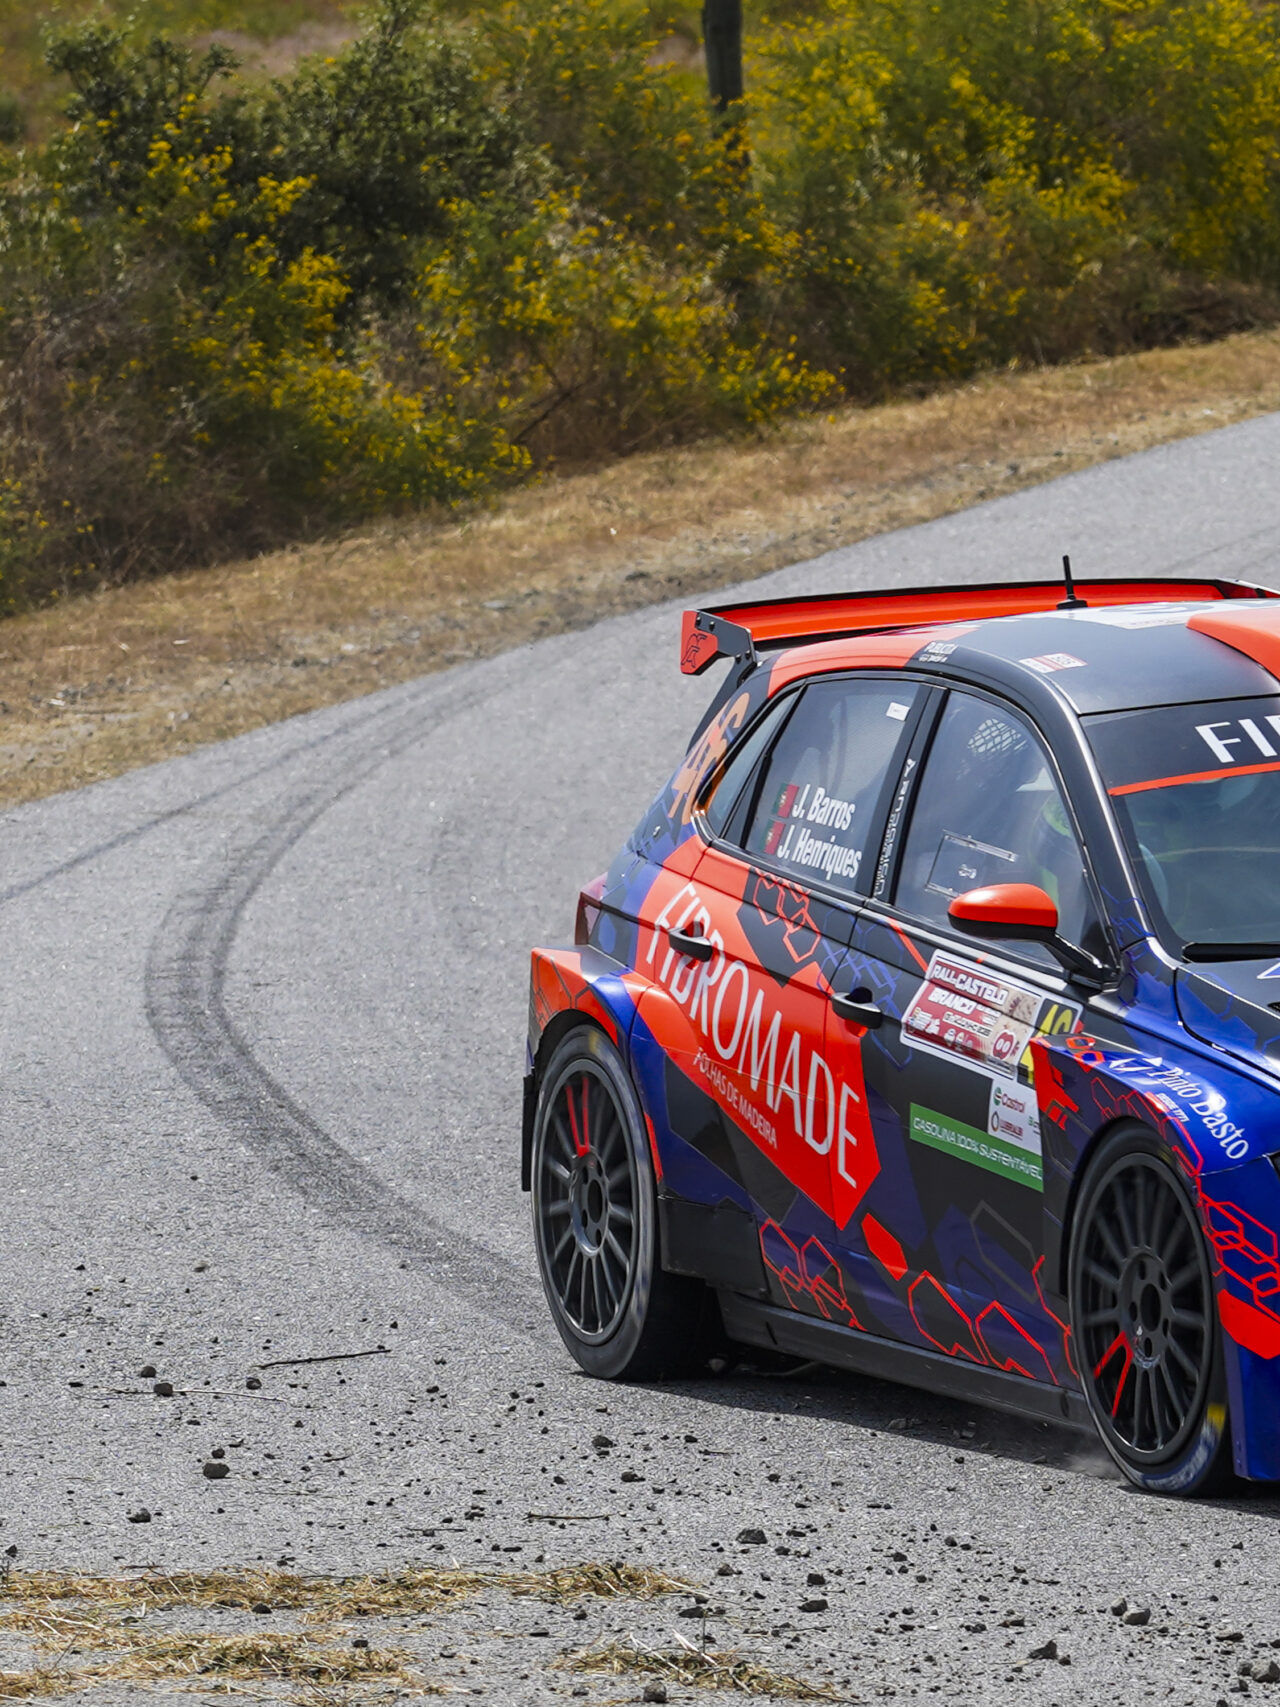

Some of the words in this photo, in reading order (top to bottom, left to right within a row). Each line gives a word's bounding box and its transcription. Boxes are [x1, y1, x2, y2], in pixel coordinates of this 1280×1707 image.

[791, 783, 811, 819] J.
[806, 787, 856, 831] Barros
[776, 824, 796, 860] J.
[791, 828, 863, 881] Henriques
[954, 973, 1009, 1006] CASTELO
[646, 881, 860, 1189] FIBROMADE
[726, 1081, 739, 1110] DE
[738, 1094, 778, 1150] MADEIRA
[912, 1116, 956, 1144] GASOLINA
[1146, 1065, 1203, 1099] Pinto
[1188, 1096, 1249, 1159] Basto
